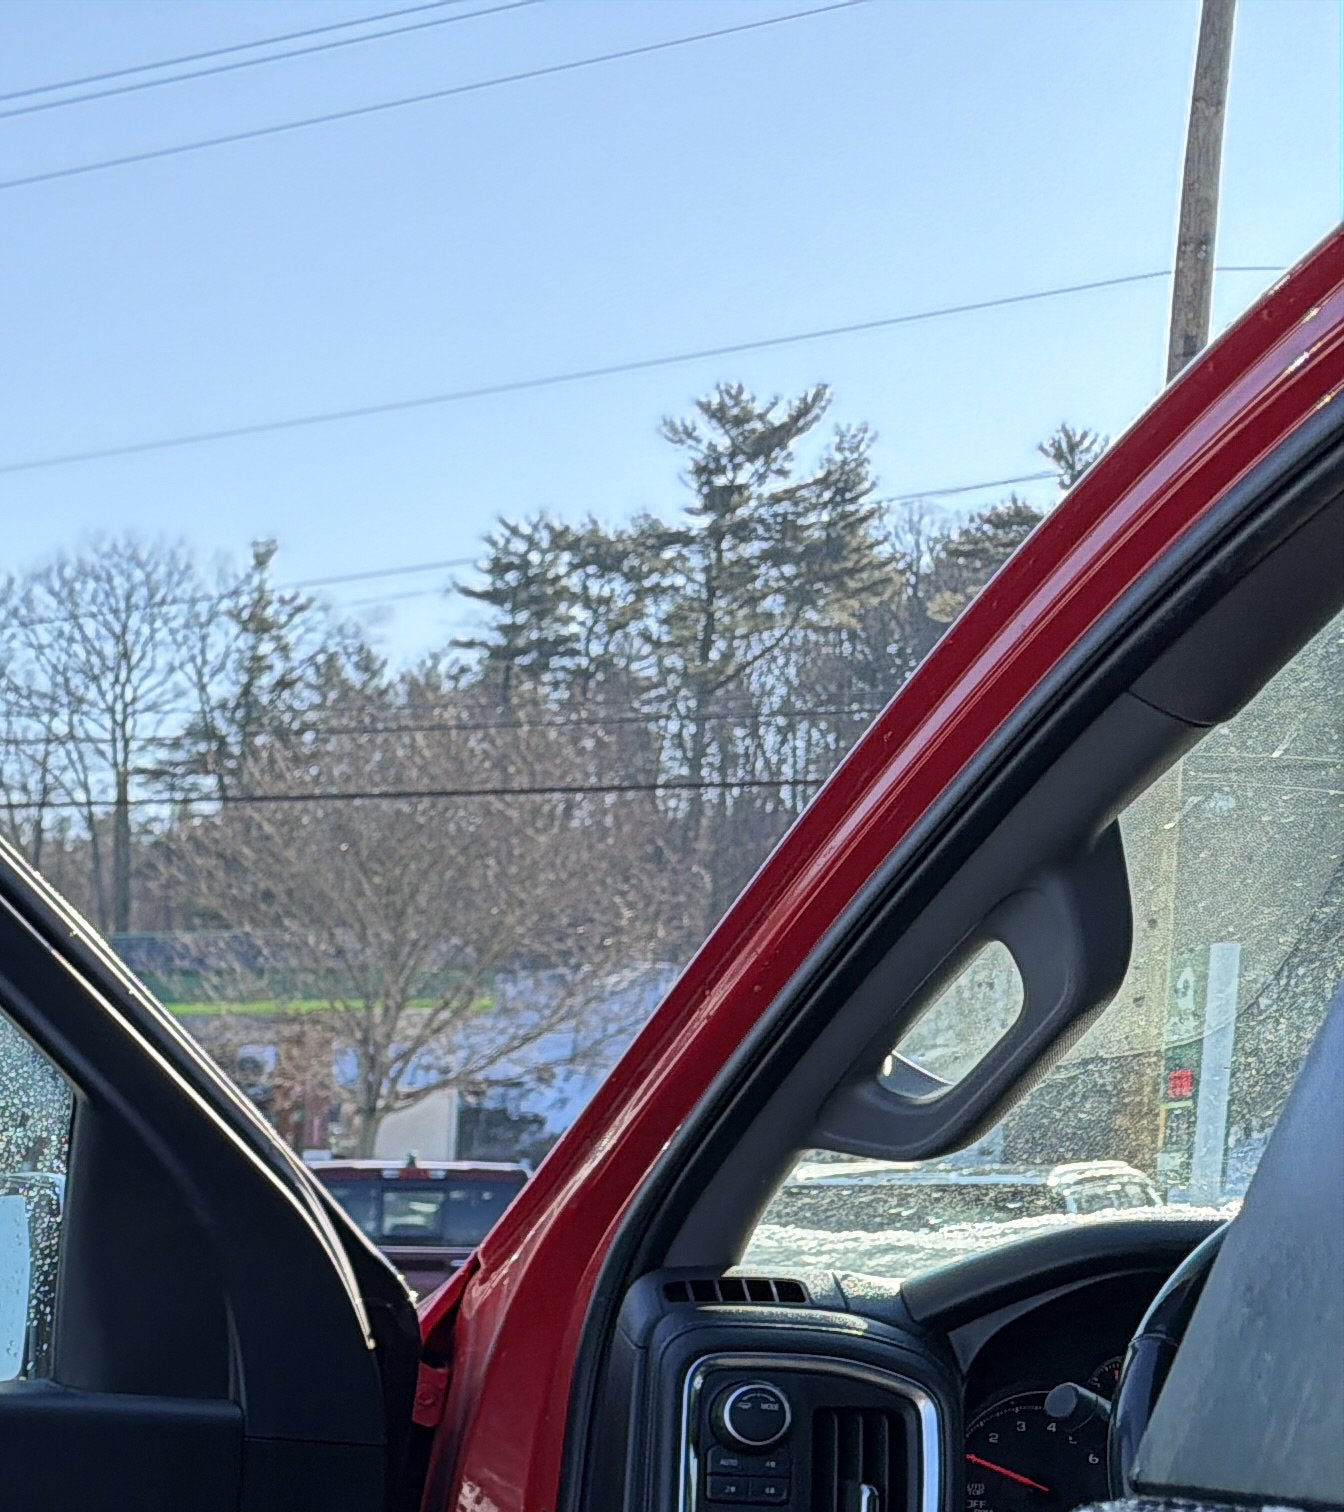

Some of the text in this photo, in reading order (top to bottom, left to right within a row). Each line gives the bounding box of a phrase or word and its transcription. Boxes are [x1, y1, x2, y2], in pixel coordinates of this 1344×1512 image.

[1016, 1420, 1026, 1431] 3
[1046, 1422, 1057, 1432] 4
[988, 1432, 999, 1443] 2
